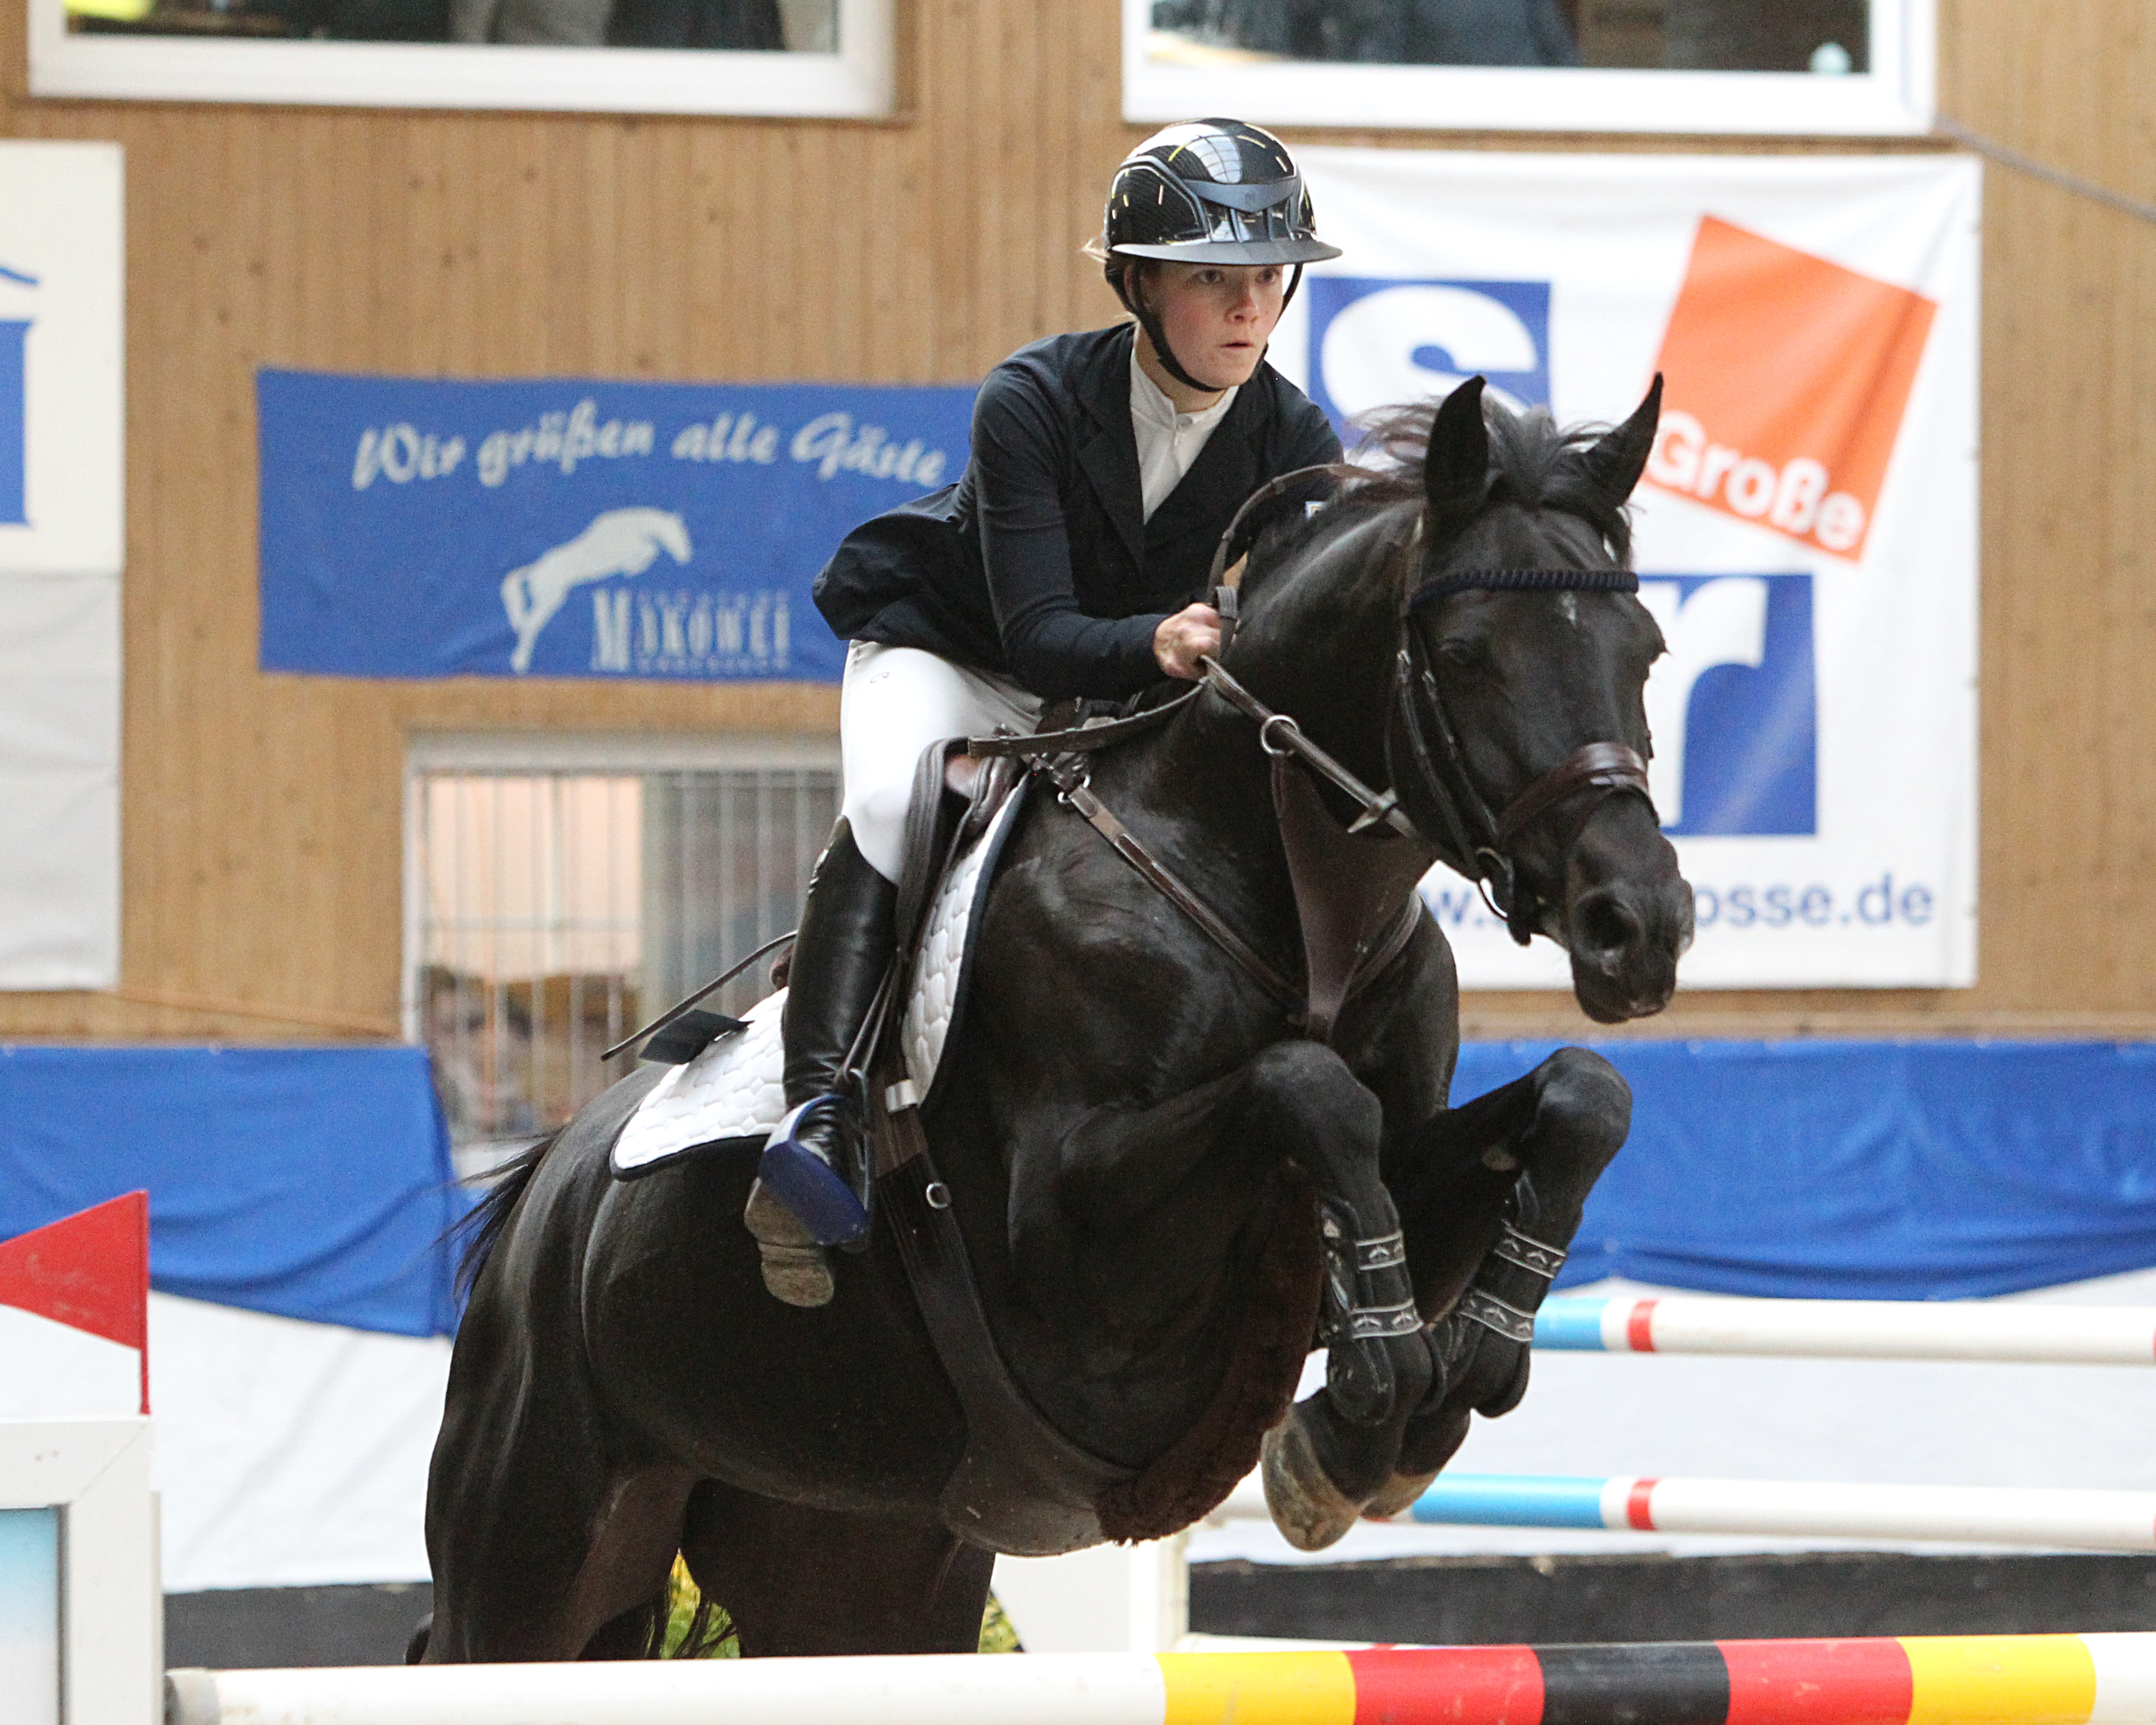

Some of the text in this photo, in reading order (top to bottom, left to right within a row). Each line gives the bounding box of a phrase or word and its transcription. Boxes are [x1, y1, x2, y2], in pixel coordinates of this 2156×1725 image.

[353, 398, 947, 490] Wir grüßen alle Gäste
[1649, 412, 1865, 550] Große
